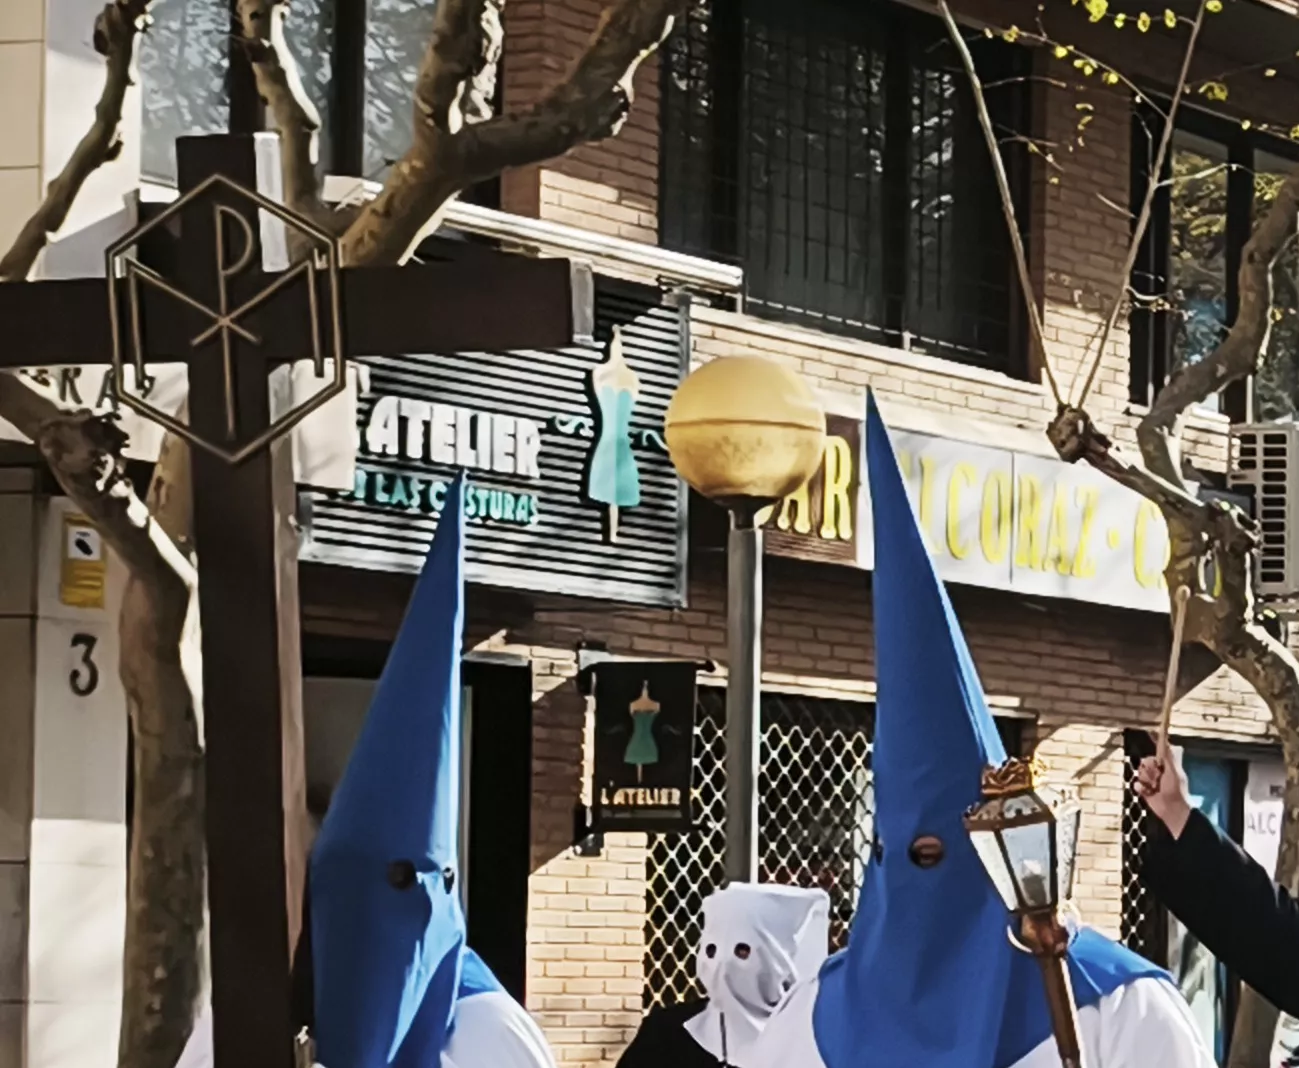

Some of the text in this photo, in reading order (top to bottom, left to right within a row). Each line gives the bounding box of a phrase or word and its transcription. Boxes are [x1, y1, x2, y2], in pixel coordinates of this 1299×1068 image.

[429, 481, 539, 526] CSTURAS
[900, 450, 1099, 578] LCORAZ
[69, 632, 99, 697] 3
[600, 779, 682, 806] L'ATELIER
